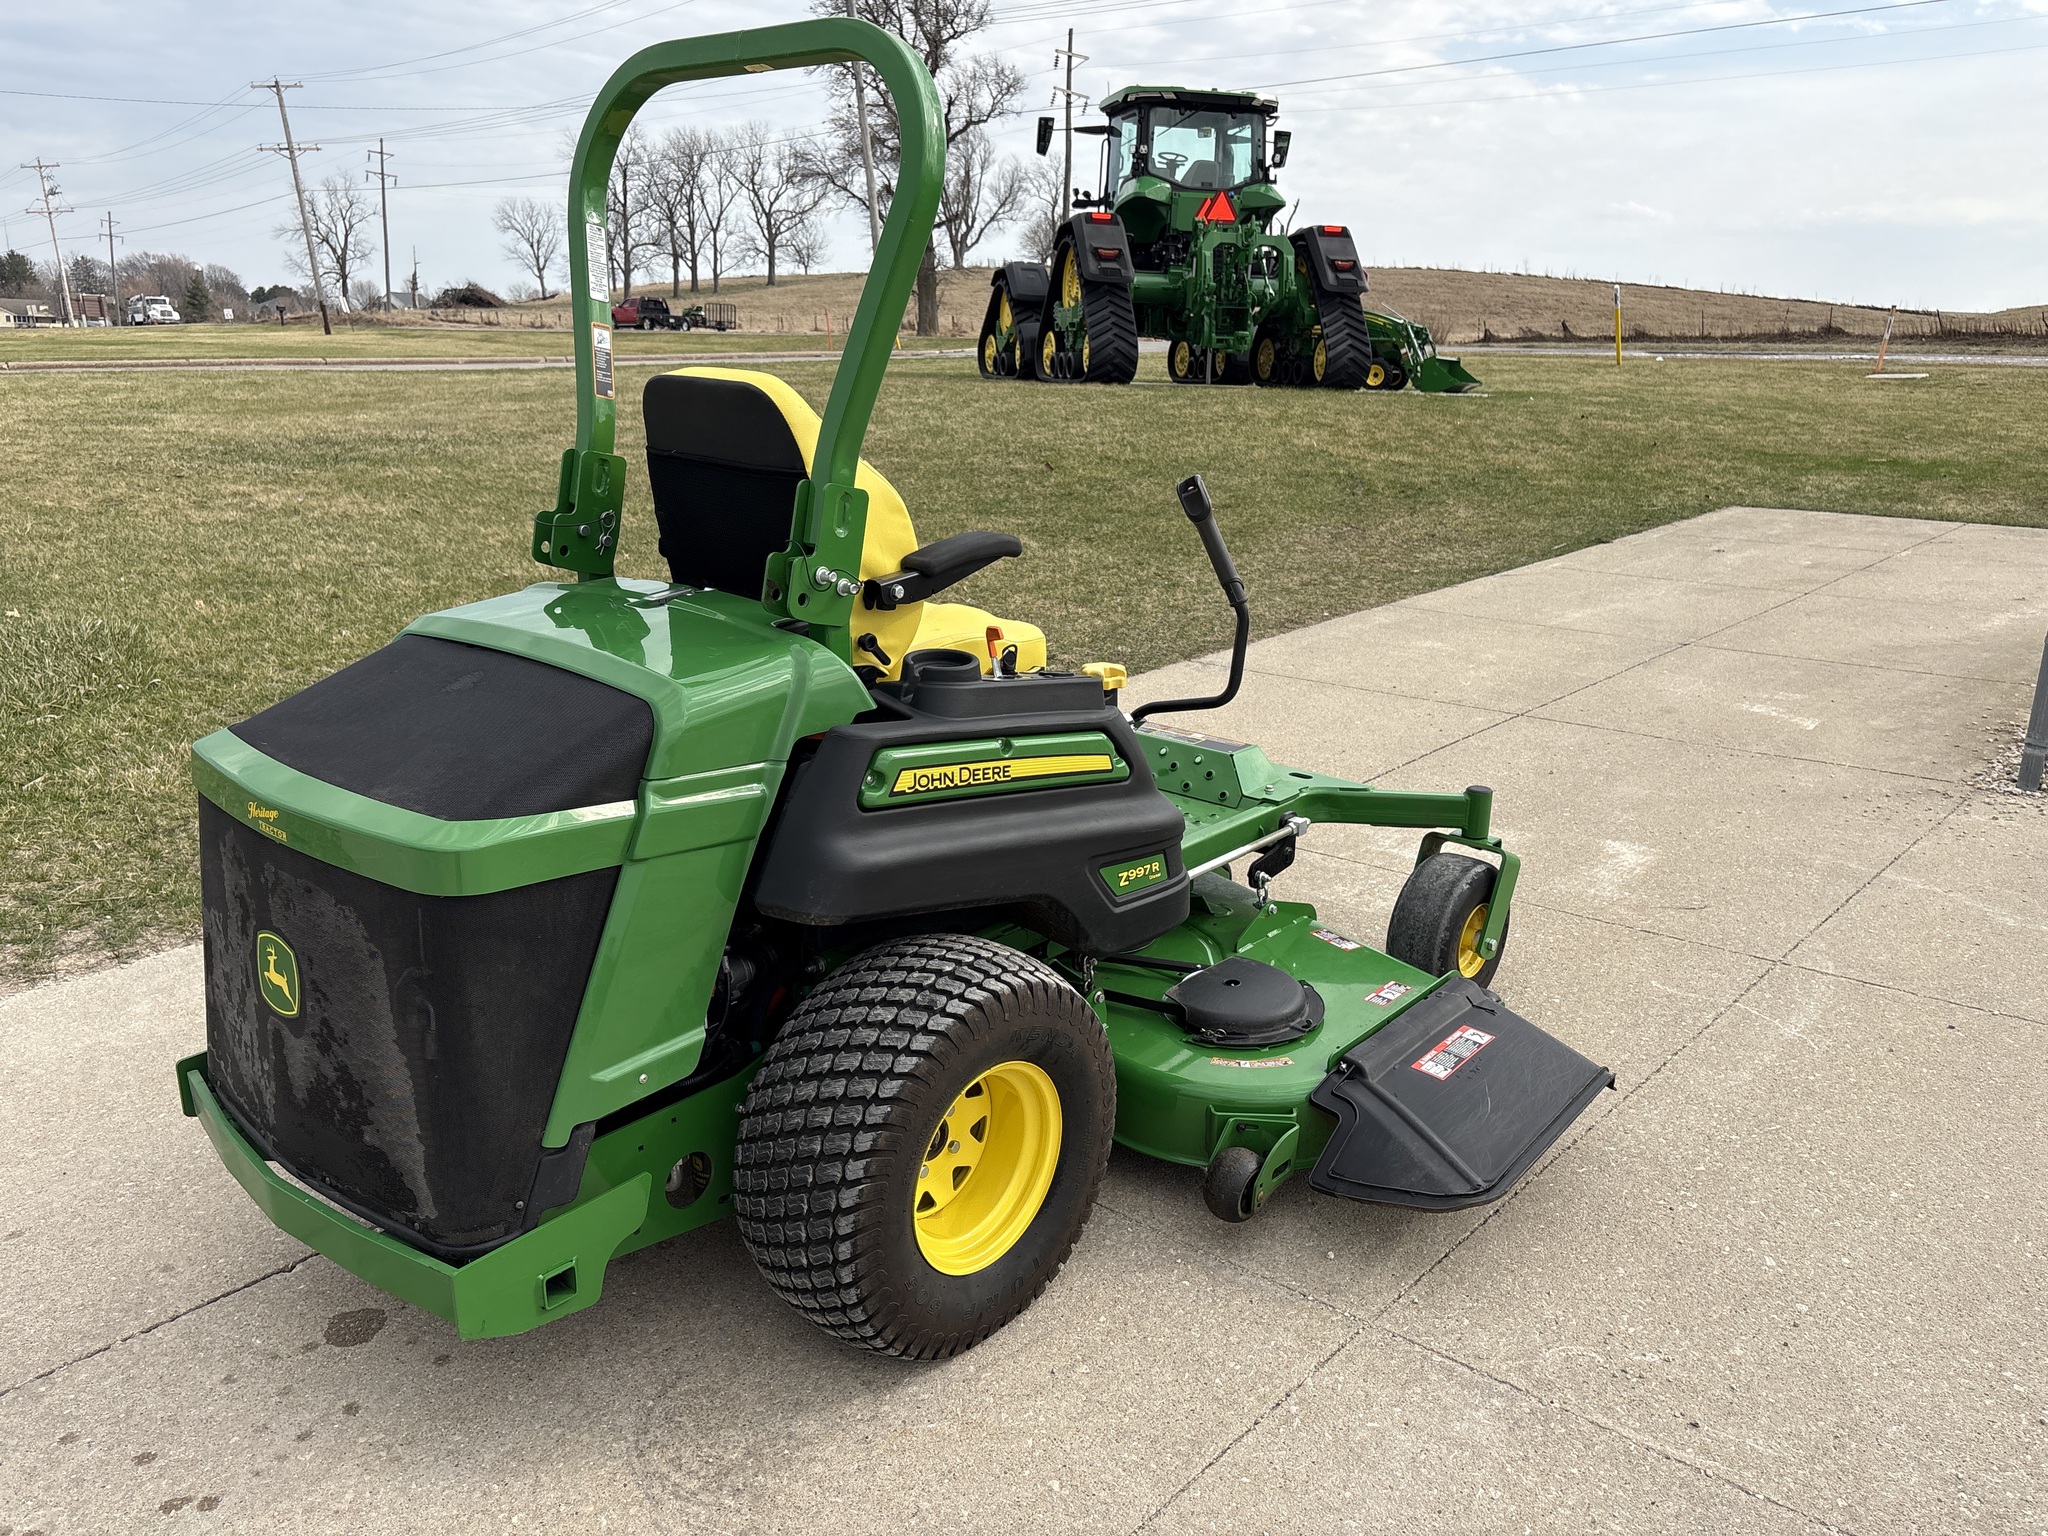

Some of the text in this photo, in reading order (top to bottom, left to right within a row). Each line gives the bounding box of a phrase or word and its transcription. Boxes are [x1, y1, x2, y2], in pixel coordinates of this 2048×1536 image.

[906, 764, 1012, 791] JOHN DEERE
[247, 801, 279, 823] Heritage
[1118, 861, 1160, 887] Z997R
[1008, 1024, 1081, 1061] KENDA
[960, 1254, 1044, 1322] TURF
